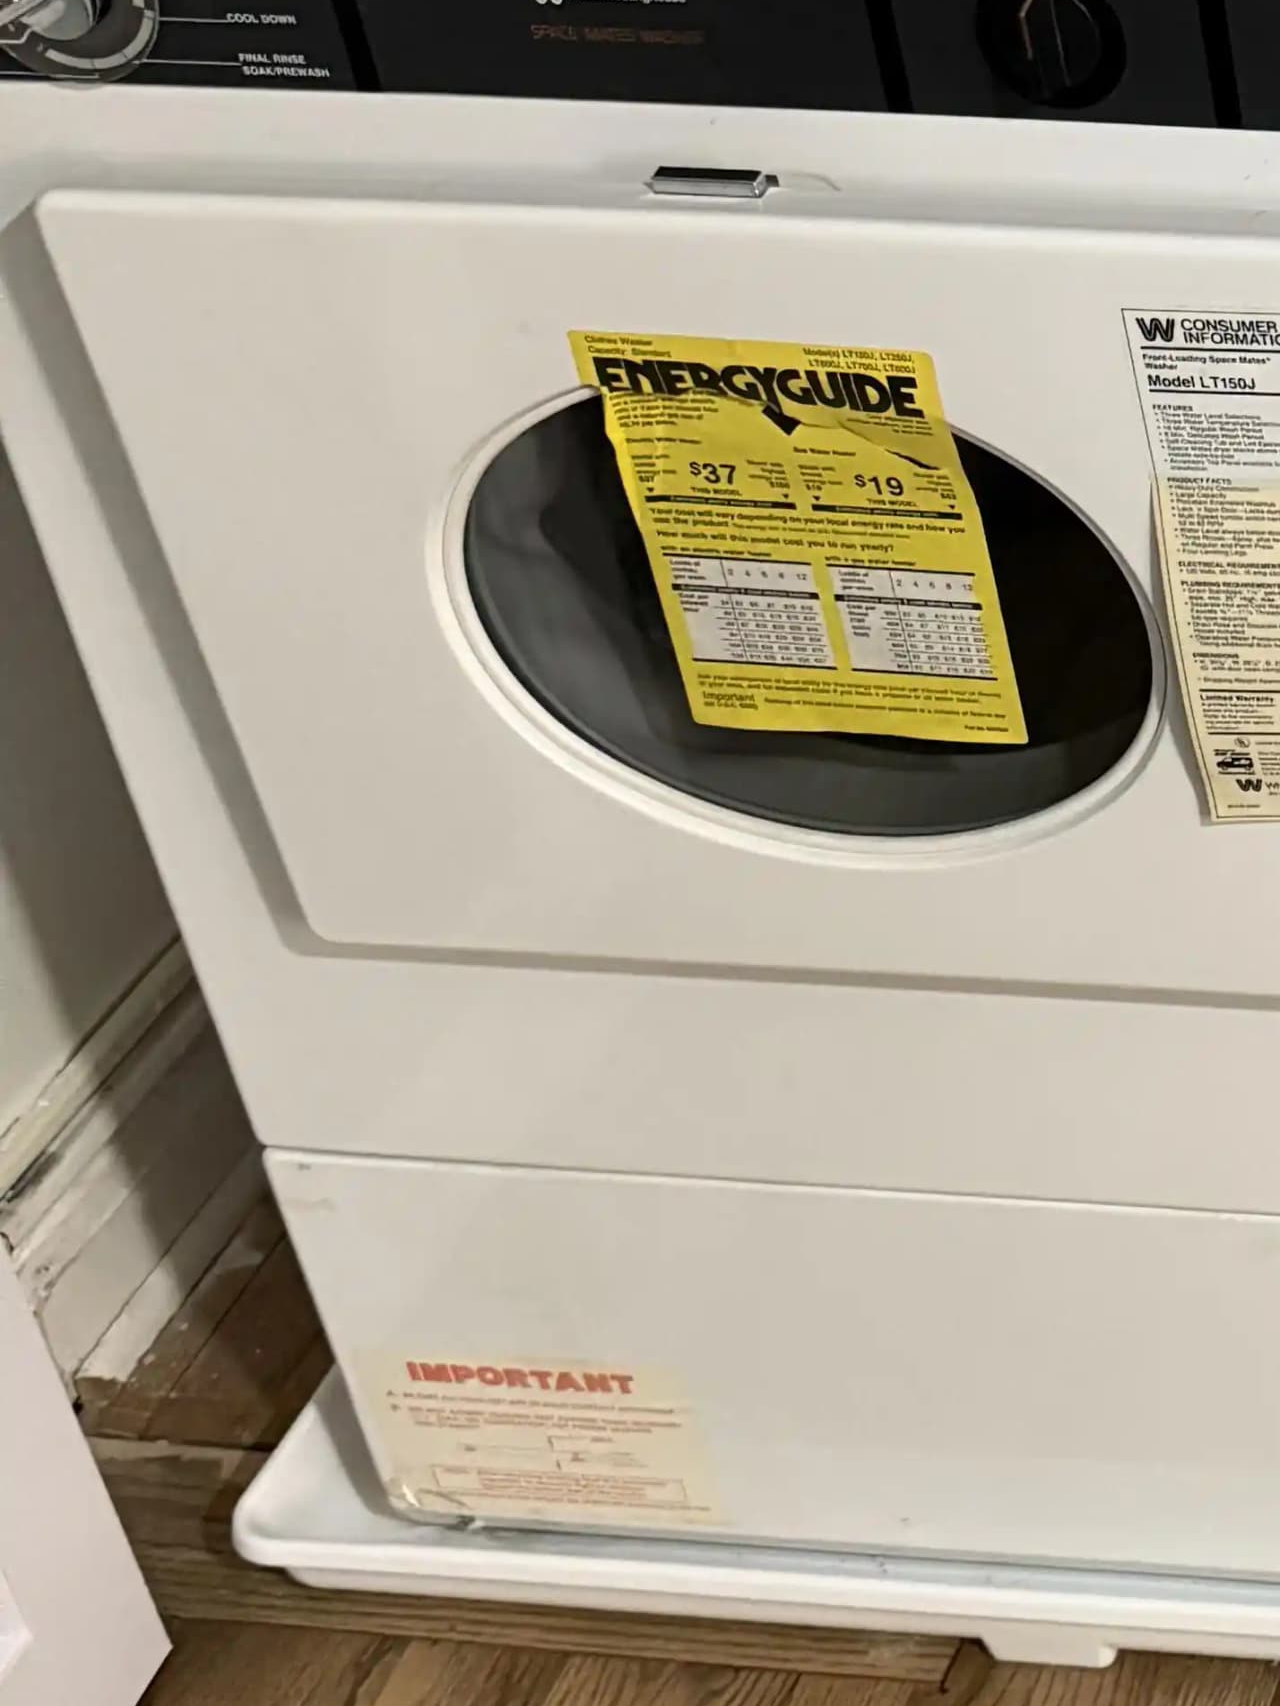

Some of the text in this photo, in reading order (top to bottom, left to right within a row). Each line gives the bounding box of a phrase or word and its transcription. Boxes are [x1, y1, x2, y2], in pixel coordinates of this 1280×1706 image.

[226, 13, 296, 24] COOL DOWN
[1180, 319, 1278, 333] CONSUMER
[592, 356, 926, 419] ENERGYGUIDE
[1147, 374, 1256, 390] Model LT150J
[689, 461, 736, 485] $37
[854, 474, 904, 496] $19
[406, 1361, 633, 1394] IMPORTANT
